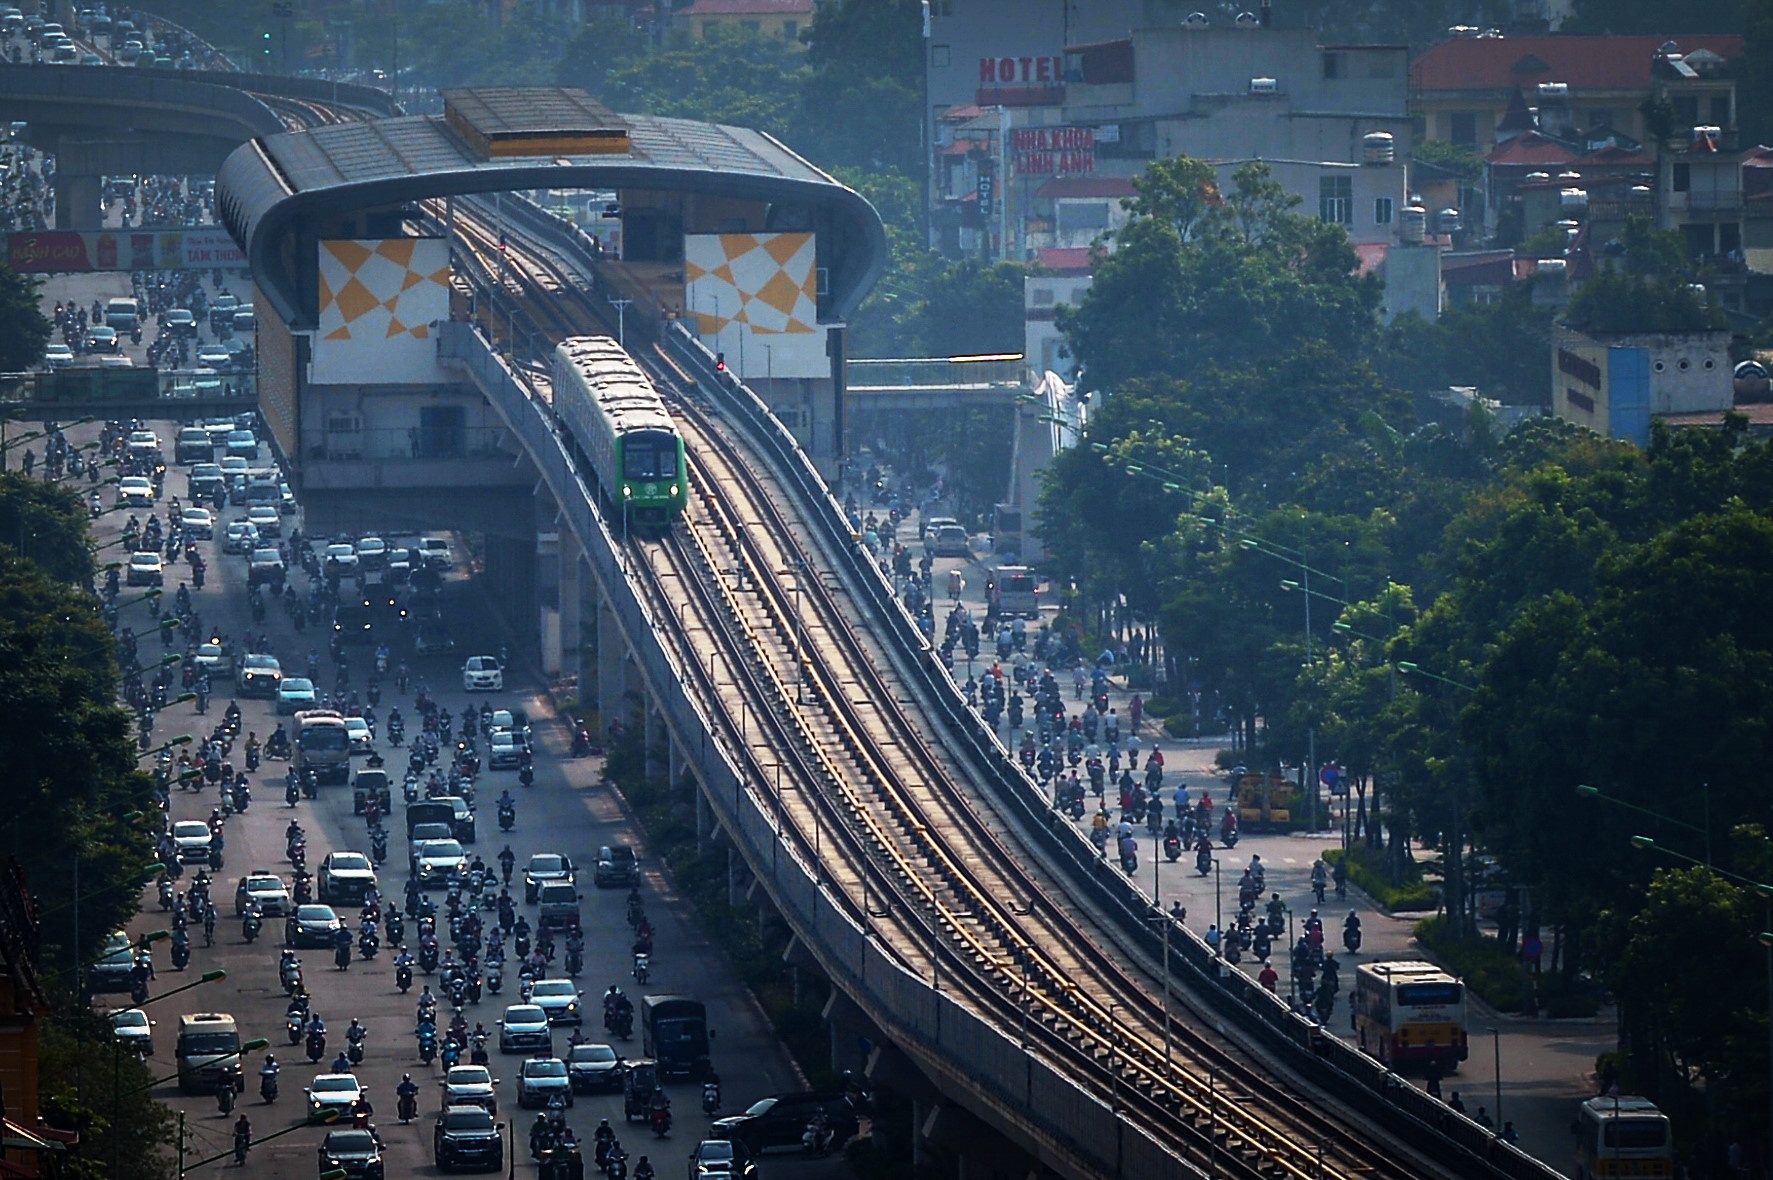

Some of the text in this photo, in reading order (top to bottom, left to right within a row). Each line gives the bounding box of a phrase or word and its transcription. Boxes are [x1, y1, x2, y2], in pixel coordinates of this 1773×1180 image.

[979, 57, 1064, 82] HOTEL
[1052, 127, 1093, 148] KHOA
[1016, 152, 1053, 174] LINH
[979, 176, 991, 214] HOTEL
